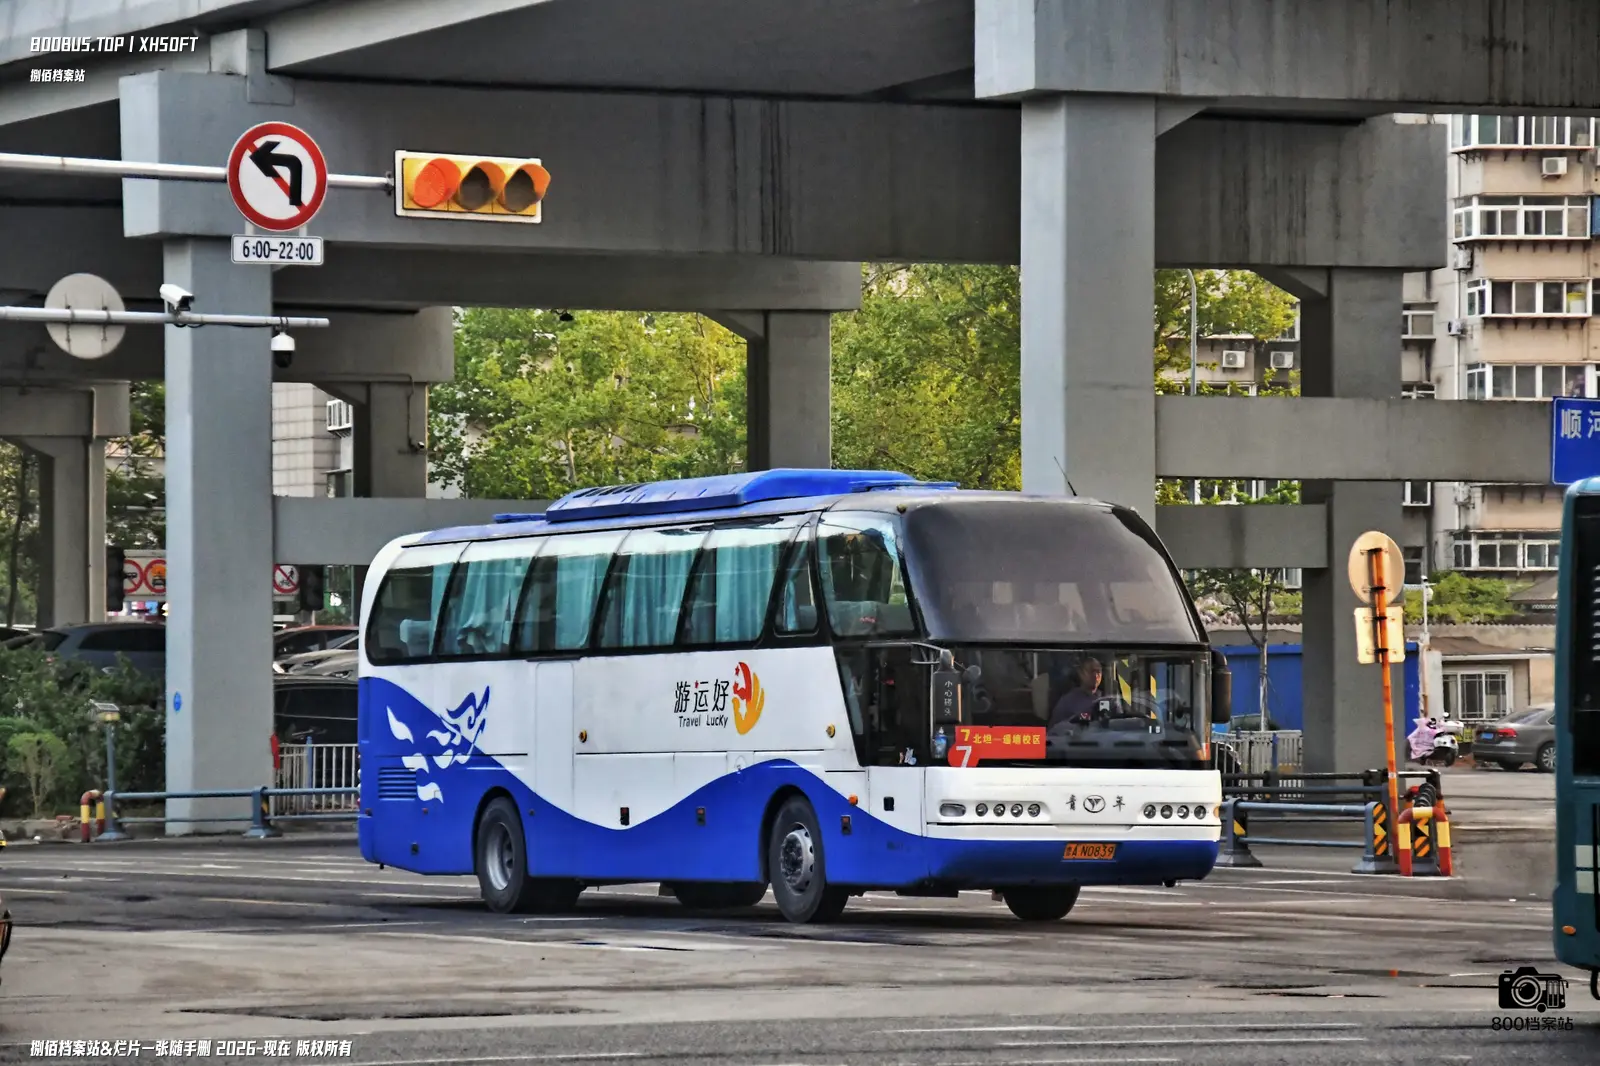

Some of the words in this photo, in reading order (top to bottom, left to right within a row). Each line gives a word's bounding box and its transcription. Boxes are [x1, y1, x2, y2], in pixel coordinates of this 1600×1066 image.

[242, 240, 314, 260] 6:00-22:00
[674, 679, 730, 713] 游运好
[679, 715, 701, 727] Travel
[960, 728, 971, 742] 7
[956, 745, 972, 768] 7
